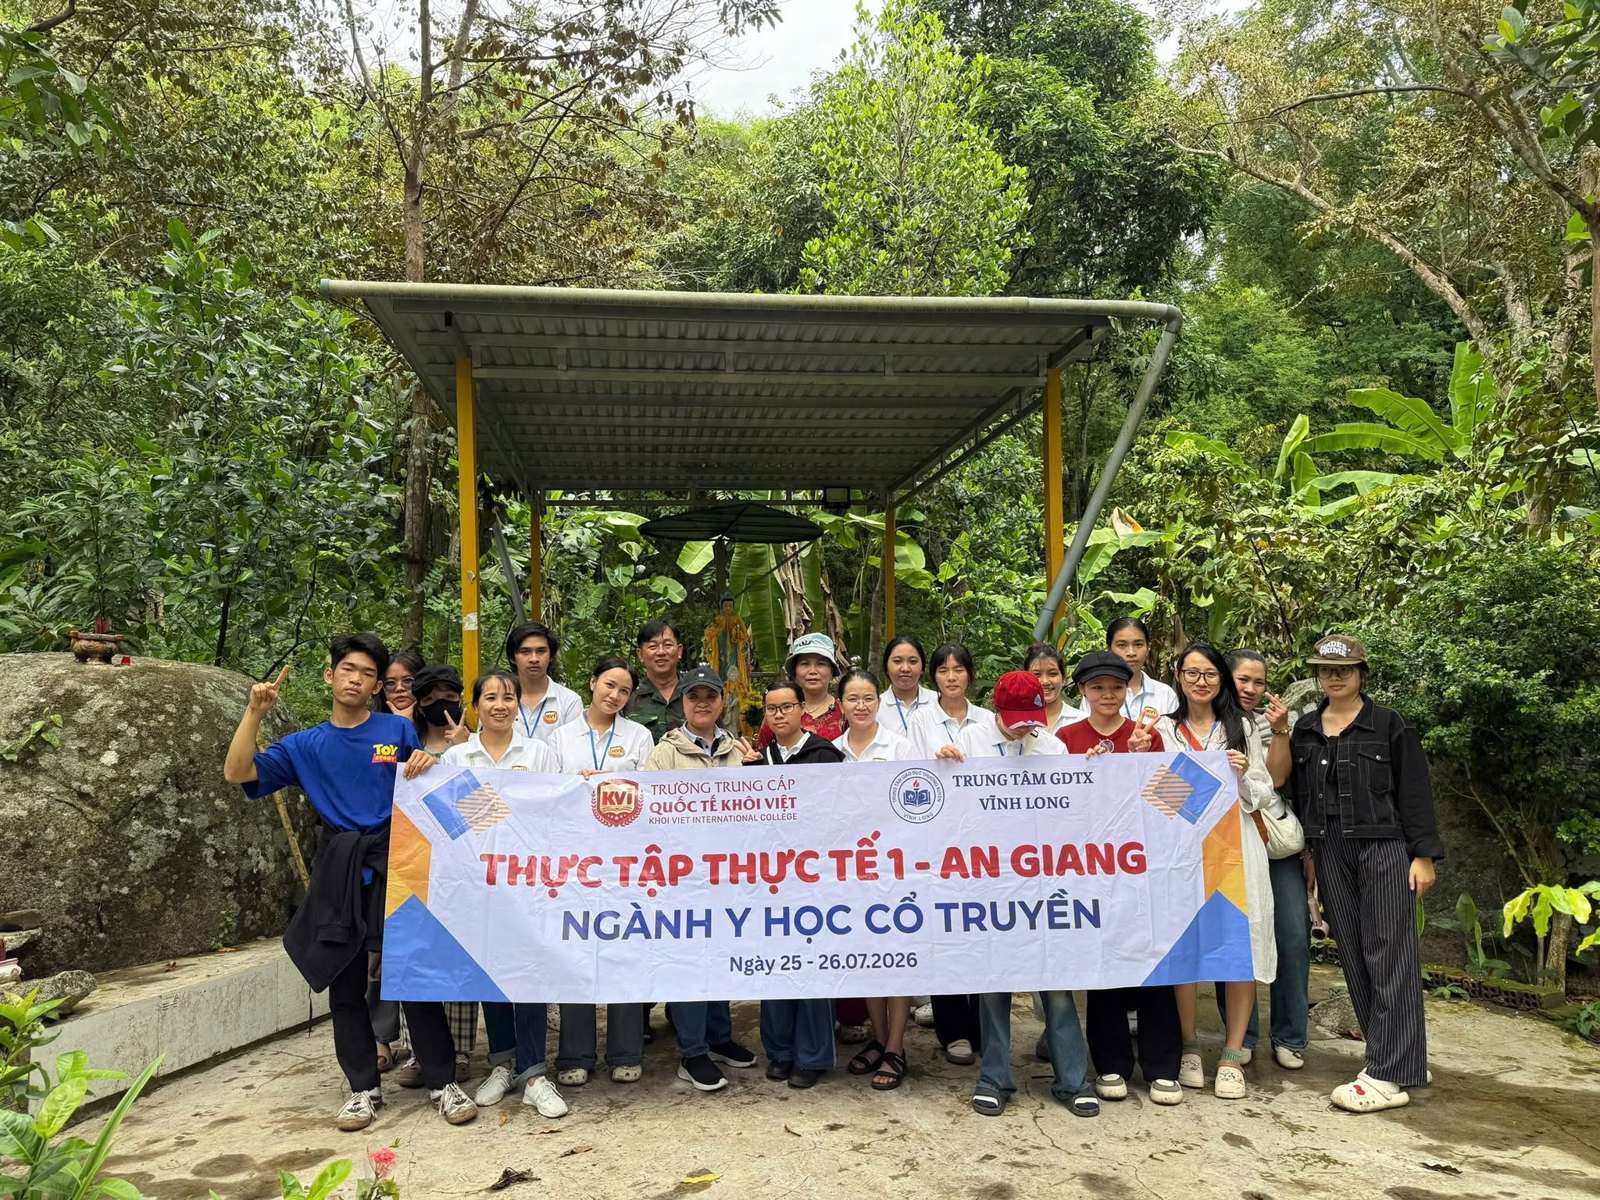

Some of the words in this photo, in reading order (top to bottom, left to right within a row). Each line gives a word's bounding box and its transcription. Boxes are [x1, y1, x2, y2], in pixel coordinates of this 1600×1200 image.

[373, 744, 398, 756] TOY
[651, 781, 710, 795] TRƯỜNG
[715, 780, 763, 792] TRUNG
[767, 775, 795, 791] CẤP
[952, 774, 1007, 787] TRUNG
[1010, 770, 1046, 785] TÂM
[1050, 772, 1094, 785] GDTX
[649, 796, 697, 815] QUỐC
[701, 795, 717, 812] TẾ
[722, 796, 760, 811] KHÔI
[764, 795, 797, 812] VIỆT
[979, 795, 1022, 810] VĨNH
[1026, 796, 1070, 809] LONG
[693, 815, 758, 823] INTERNATIONAL
[760, 813, 797, 821] COLLEGE
[480, 854, 603, 898] THỰC
[613, 844, 693, 897] TẬP
[702, 849, 820, 894] THỰC
[828, 831, 880, 881] TẾ
[887, 848, 904, 880] 1
[915, 862, 930, 870] -
[940, 846, 1000, 879] AN
[1011, 842, 1146, 877] GIANG
[562, 902, 711, 940] NGÀNH
[725, 908, 751, 937] Y
[765, 905, 852, 944] HỌC
[865, 892, 923, 934] CỔ
[935, 889, 1100, 932] TRUYỀN
[730, 956, 775, 976] Ngày
[781, 955, 801, 970] 25
[819, 952, 917, 969] 26.07.2026
